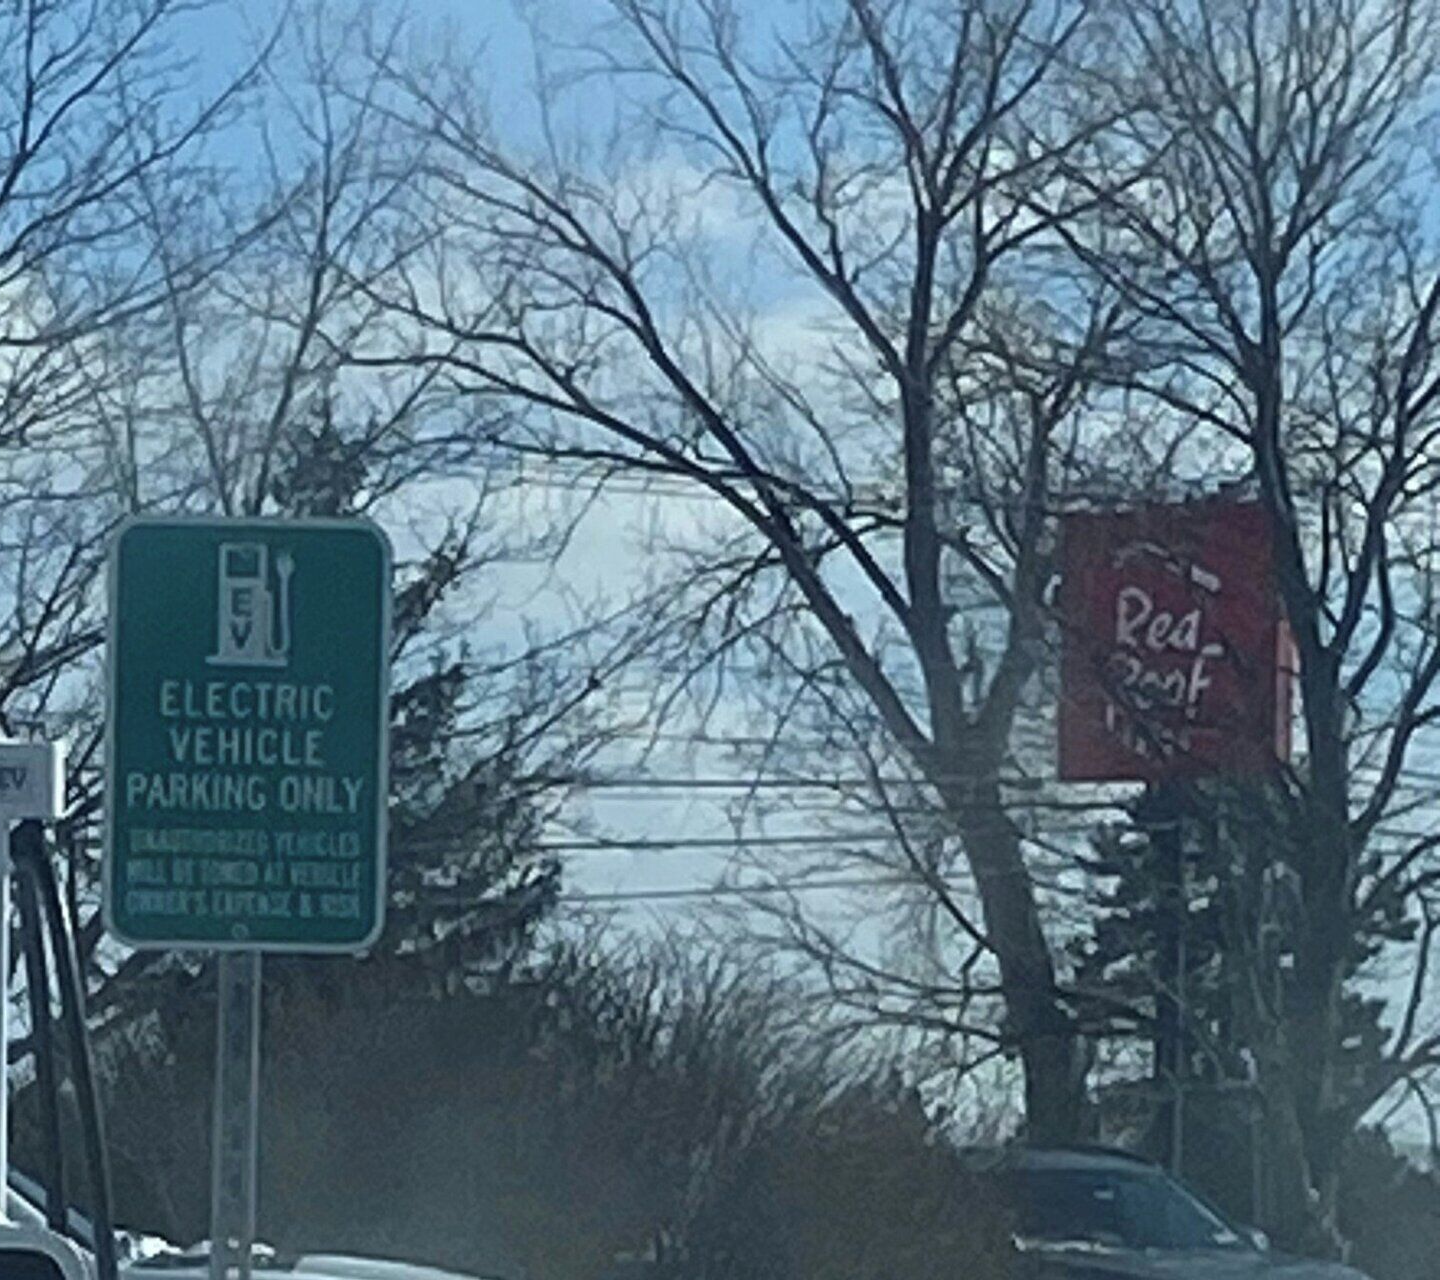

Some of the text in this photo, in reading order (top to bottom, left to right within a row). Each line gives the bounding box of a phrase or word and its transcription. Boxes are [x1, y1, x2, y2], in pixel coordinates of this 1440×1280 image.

[1115, 585, 1202, 651] Red
[161, 680, 334, 721] ELECTRIC
[168, 727, 324, 767] VEHICLE
[127, 772, 364, 814] PARKING ONLY
